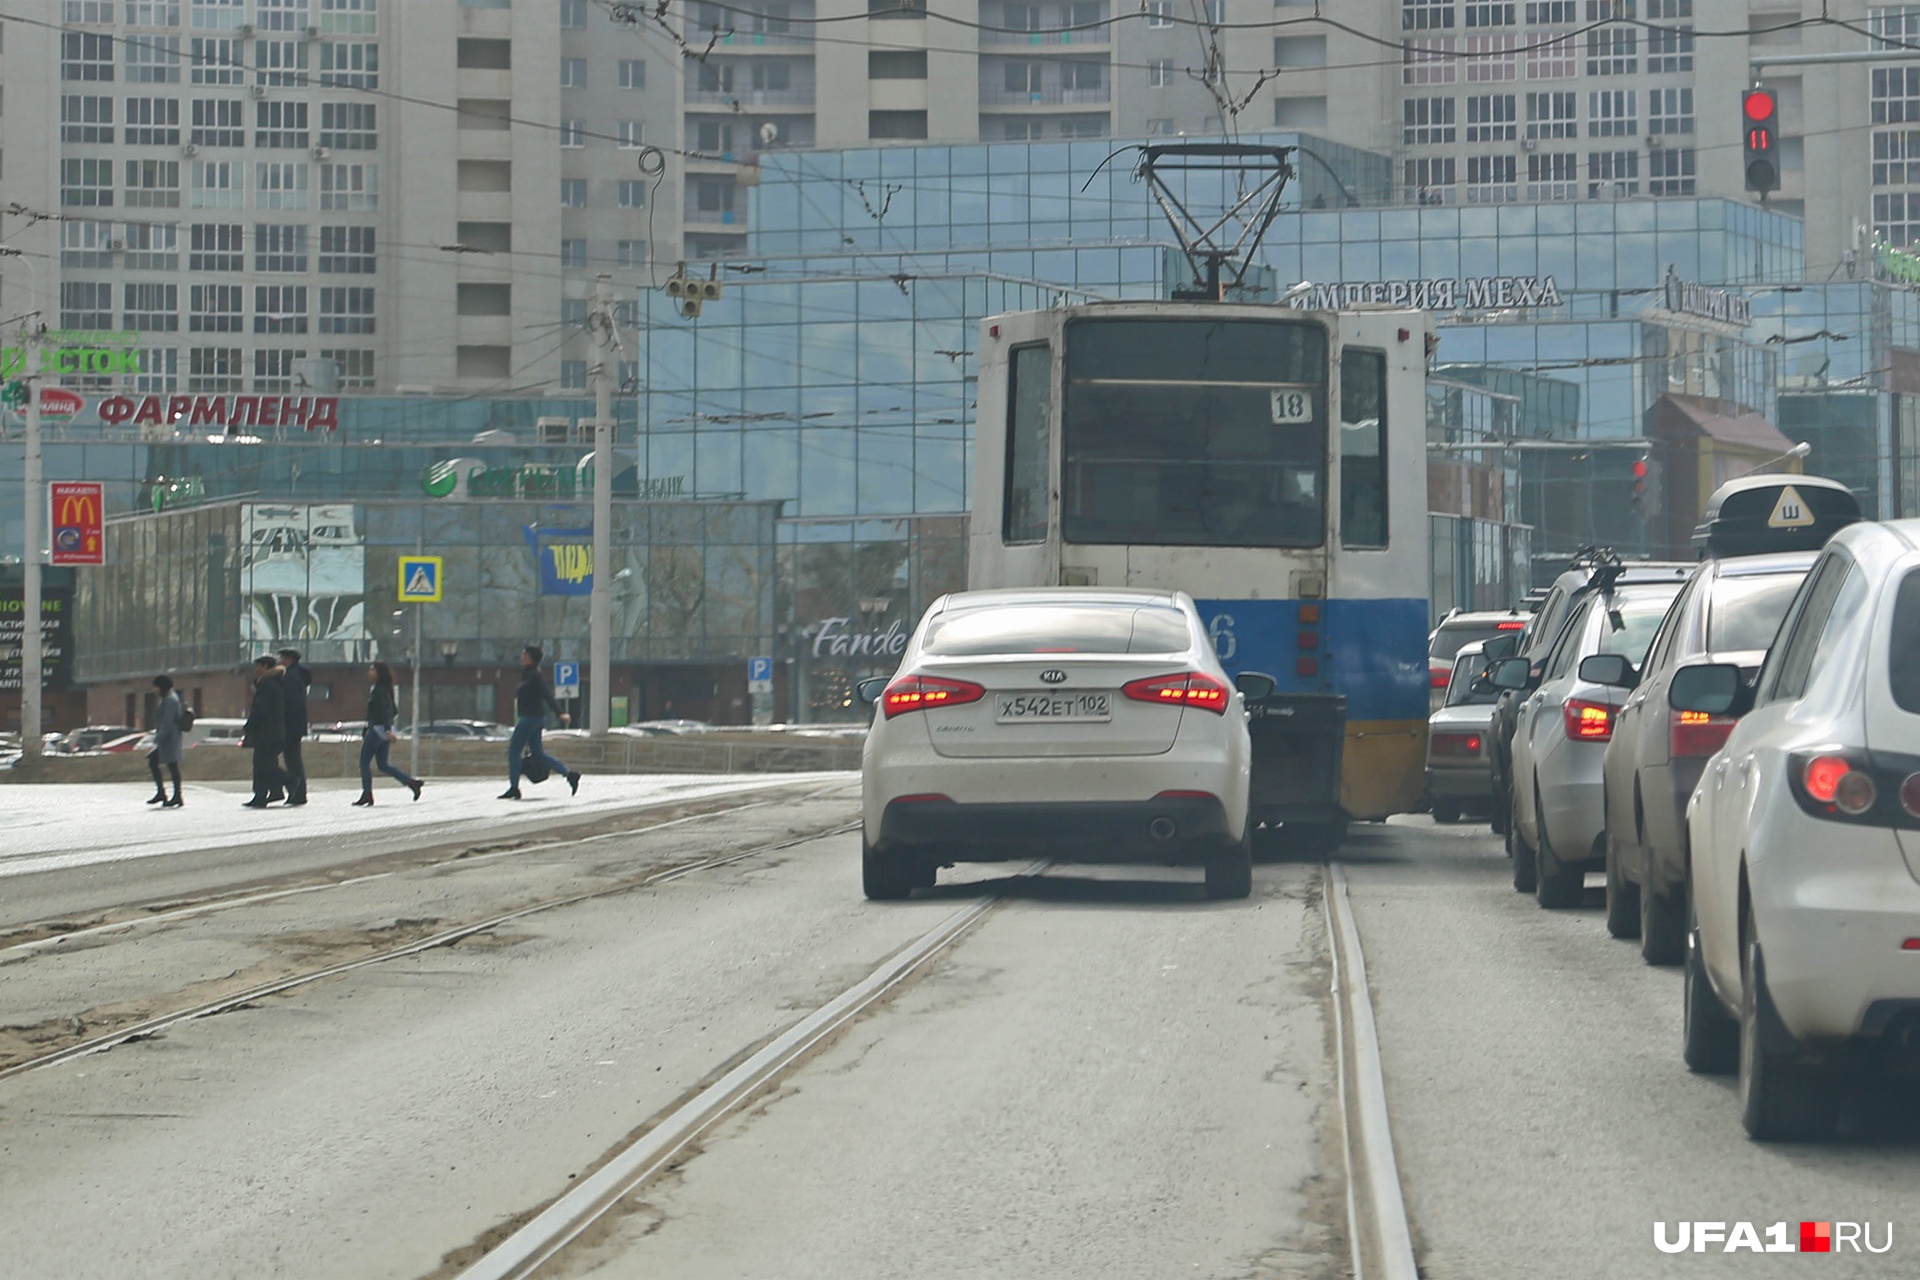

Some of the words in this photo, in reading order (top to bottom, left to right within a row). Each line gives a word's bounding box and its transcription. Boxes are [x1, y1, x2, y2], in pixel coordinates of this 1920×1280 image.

[1750, 129, 1767, 151] 11
[1287, 278, 1456, 310] ИМПЕРИЯ
[1463, 275, 1565, 309] МЕХА
[97, 395, 339, 432] ФАРМЛЕНД
[1275, 393, 1304, 420] 18
[1782, 505, 1799, 520] Ш
[1210, 614, 1236, 659] 6
[1043, 672, 1063, 681] KIA
[1079, 695, 1107, 711] 102
